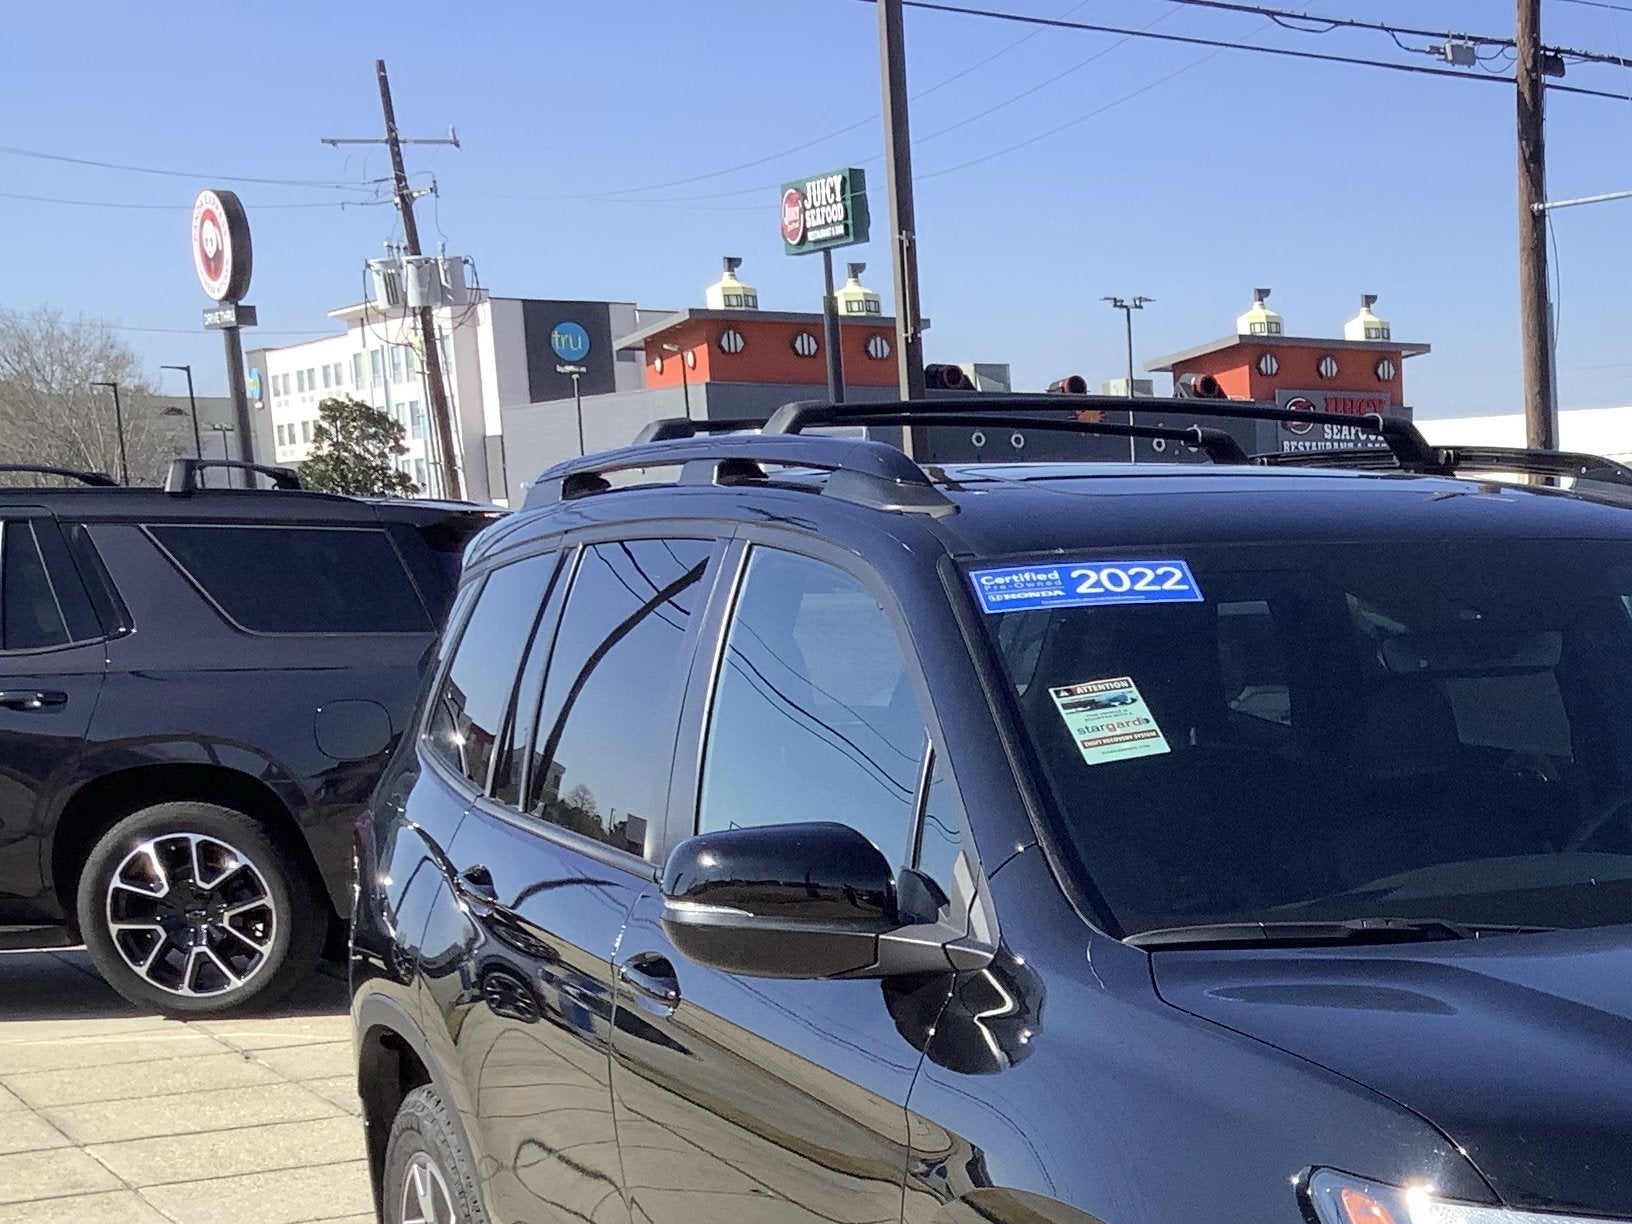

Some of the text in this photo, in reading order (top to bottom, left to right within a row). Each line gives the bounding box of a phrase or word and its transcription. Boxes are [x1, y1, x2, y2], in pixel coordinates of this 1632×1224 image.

[804, 175, 842, 209] JUICY
[805, 202, 844, 228] SEAFOOD
[551, 330, 583, 351] tru
[1323, 423, 1386, 441] SEAFO
[980, 569, 1060, 587] Certified
[984, 579, 1063, 592] Pre-Owned
[1070, 566, 1190, 594] 2022
[1003, 589, 1067, 601] HONDA
[1076, 680, 1130, 695] ATTENTION
